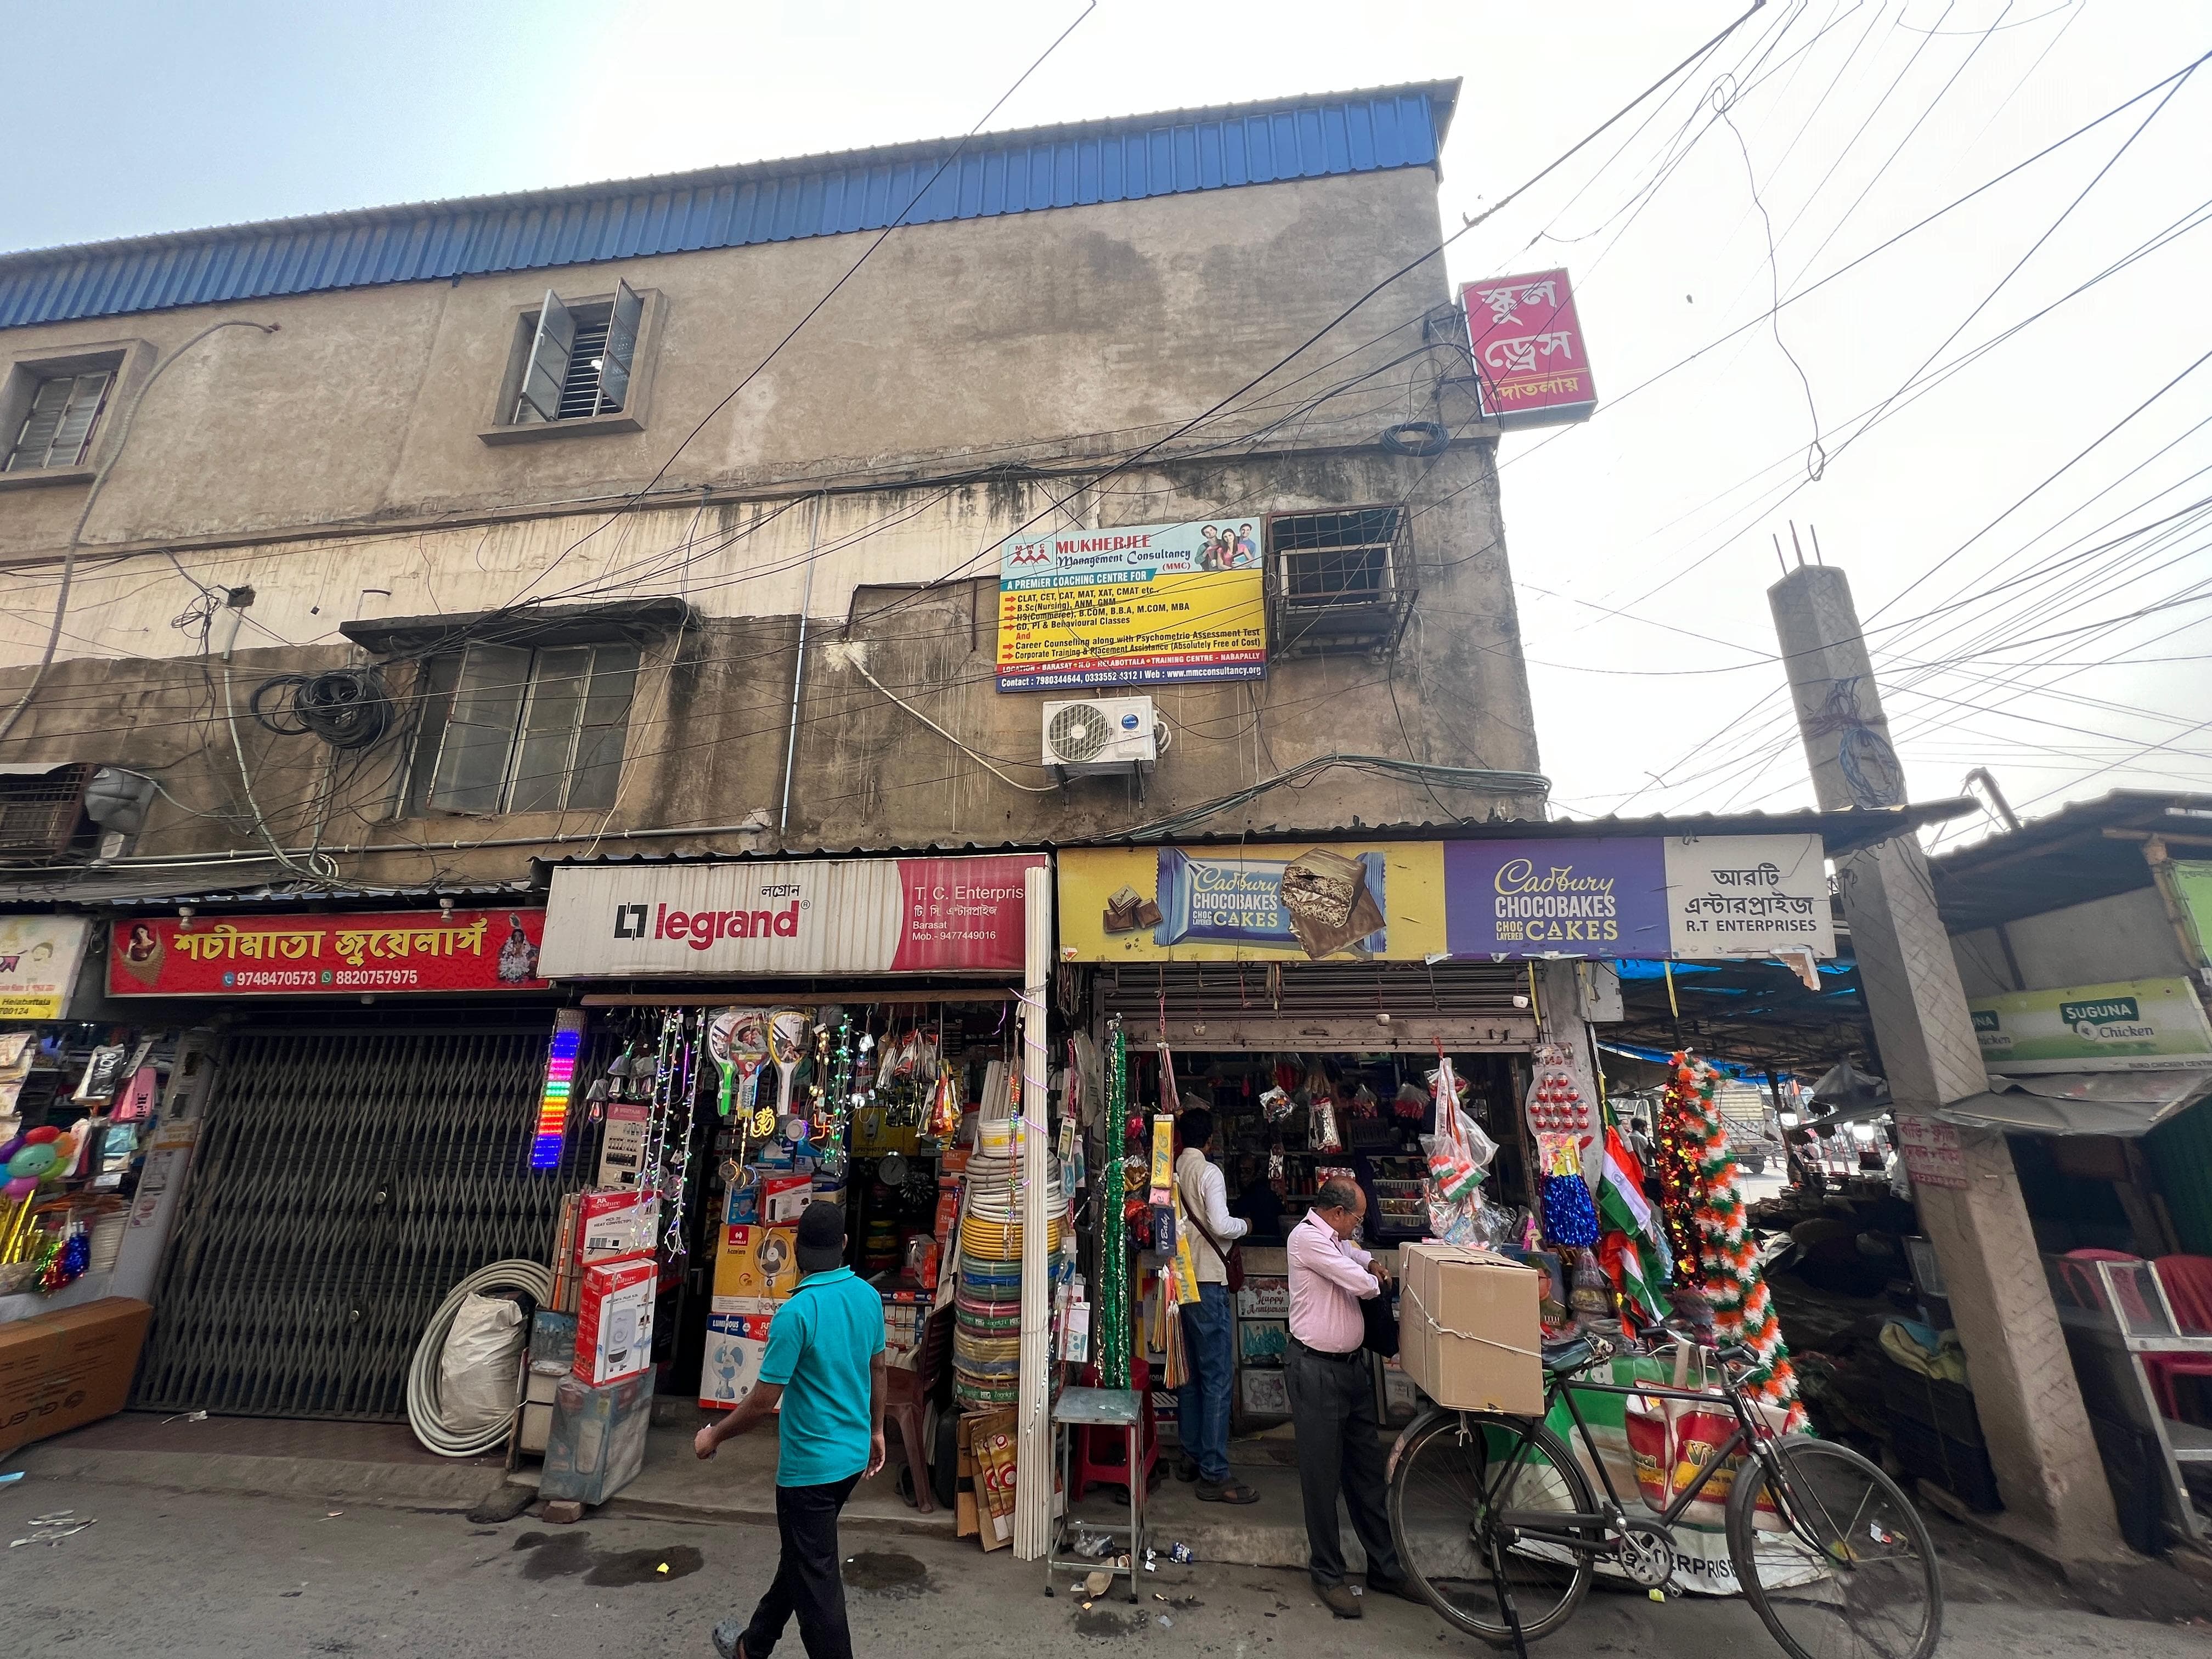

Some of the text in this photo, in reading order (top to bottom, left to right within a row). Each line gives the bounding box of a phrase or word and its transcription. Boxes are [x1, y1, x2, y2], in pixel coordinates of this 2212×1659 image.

[1476, 281, 1556, 326] স্কুল
[1485, 331, 1572, 371] ড্রেস
[1057, 534, 1151, 554] MUKHERJEE
[1057, 549, 1190, 569] Management Consultancy
[1163, 562, 1190, 571] (MMC)
[1007, 571, 1147, 590] A PREMIER COACHING CENTRE FOR
[1041, 593, 1057, 601] CET,
[1059, 591, 1075, 600] CAT,
[1077, 590, 1096, 599] MAT,
[1098, 589, 1114, 597] XAT,
[1116, 587, 1139, 595] CMAT
[1017, 601, 1072, 612] B.Sc(Nursing),
[1079, 608, 1108, 618] B.COM,
[1110, 607, 1134, 616] B.B.A,
[1137, 604, 1169, 613] M.COM,
[1171, 602, 1189, 611] MBA
[1016, 623, 1029, 631] GD,
[1051, 618, 1097, 628] Behavioural
[1099, 616, 1130, 626] Classes
[1015, 632, 1031, 640] And
[1015, 628, 1260, 650] Career Counselling along with Psychometric Assessment Test
[1015, 650, 1049, 661] Corporate
[1052, 648, 1080, 658] Training
[1090, 645, 1128, 654] Placement
[1130, 642, 1169, 652] Assistance
[1171, 640, 1211, 652] (Absolutely
[1213, 639, 1229, 648] Free
[1241, 637, 1261, 648] Cost)
[1002, 665, 1035, 673] LOCATION
[1042, 662, 1072, 670] BARASAT
[1152, 656, 1184, 664] TRAINING
[1186, 654, 1214, 663] CENTRE
[1221, 653, 1260, 661] NABAPALLY
[1001, 677, 1029, 687] Contact
[1036, 674, 1083, 685] 7980344644,
[1144, 670, 1160, 679] Web
[1167, 666, 1261, 679] www.mmcconsultancy.org
[1193, 867, 1278, 898] Cadbury
[1494, 858, 1615, 902] Cadbury
[1711, 862, 1780, 886] আরটি
[915, 884, 1025, 902] T. C. Enterpris
[1193, 893, 1278, 910] CHOCOBAKES
[946, 904, 998, 917] এন্টারপ্রাইজ
[1495, 895, 1616, 918] CHOCOBAKES
[1685, 891, 1814, 917] এন্টারপ্রাইজ
[1193, 911, 1212, 919] CHOC
[1213, 911, 1278, 928] CAKES
[654, 900, 800, 951] legrand
[912, 921, 947, 929] Barasat
[1496, 921, 1523, 932] CHOC
[1526, 919, 1618, 941] CAKES
[1686, 919, 1817, 932] R.T ENTERPRISES
[173, 917, 487, 967] শচীমাতা জুয়েলার্স
[940, 930, 996, 940] 9477449016
[1496, 932, 1523, 940] LAYERED
[237, 969, 417, 986] 9748470573 8820757975
[2066, 1003, 2132, 1020] SUGUNA
[1977, 1034, 2011, 1045] hicken
[2100, 1025, 2154, 1039] Chicken
[1160, 1213, 1170, 1240] Baby
[1256, 1295, 1284, 1305] Happy
[1246, 1304, 1289, 1314] Anniversar
